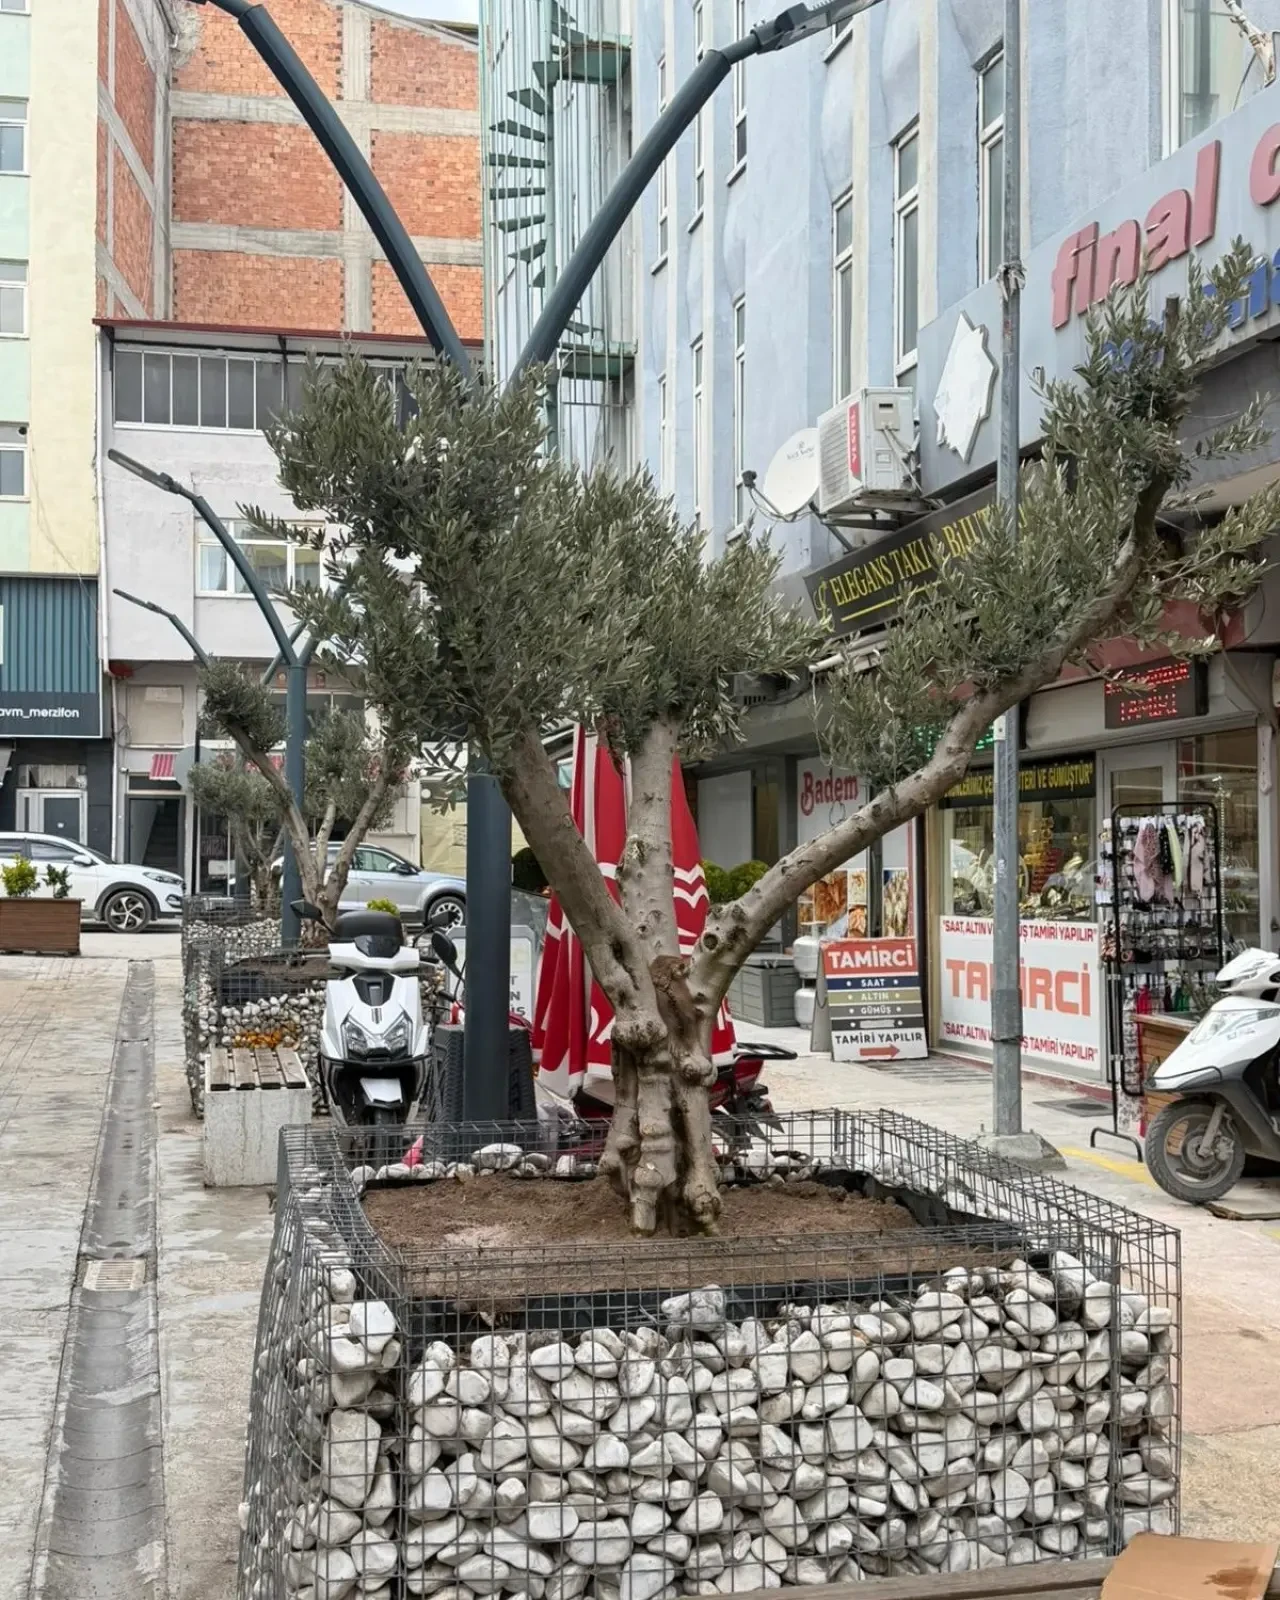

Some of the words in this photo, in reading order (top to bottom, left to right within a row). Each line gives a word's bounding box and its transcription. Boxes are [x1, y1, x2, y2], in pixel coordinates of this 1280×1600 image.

[1051, 139, 1221, 330] final
[829, 556, 894, 607] ELEGANS
[890, 538, 933, 581] TAKI
[801, 771, 859, 816] Badem
[965, 923, 987, 935] ALTIN
[1029, 924, 1058, 940] TAMİRİ
[827, 944, 913, 969] TAMİRCİ
[861, 978, 885, 987] SAAT
[946, 957, 1092, 1017] TAİRCİ
[861, 992, 889, 1001] ALTIN
[835, 1032, 876, 1045] TAMİRİ
[878, 1032, 923, 1043] YAPILIR
[965, 1026, 987, 1041] ALTIN
[1029, 1036, 1058, 1055] TAMİRİ
